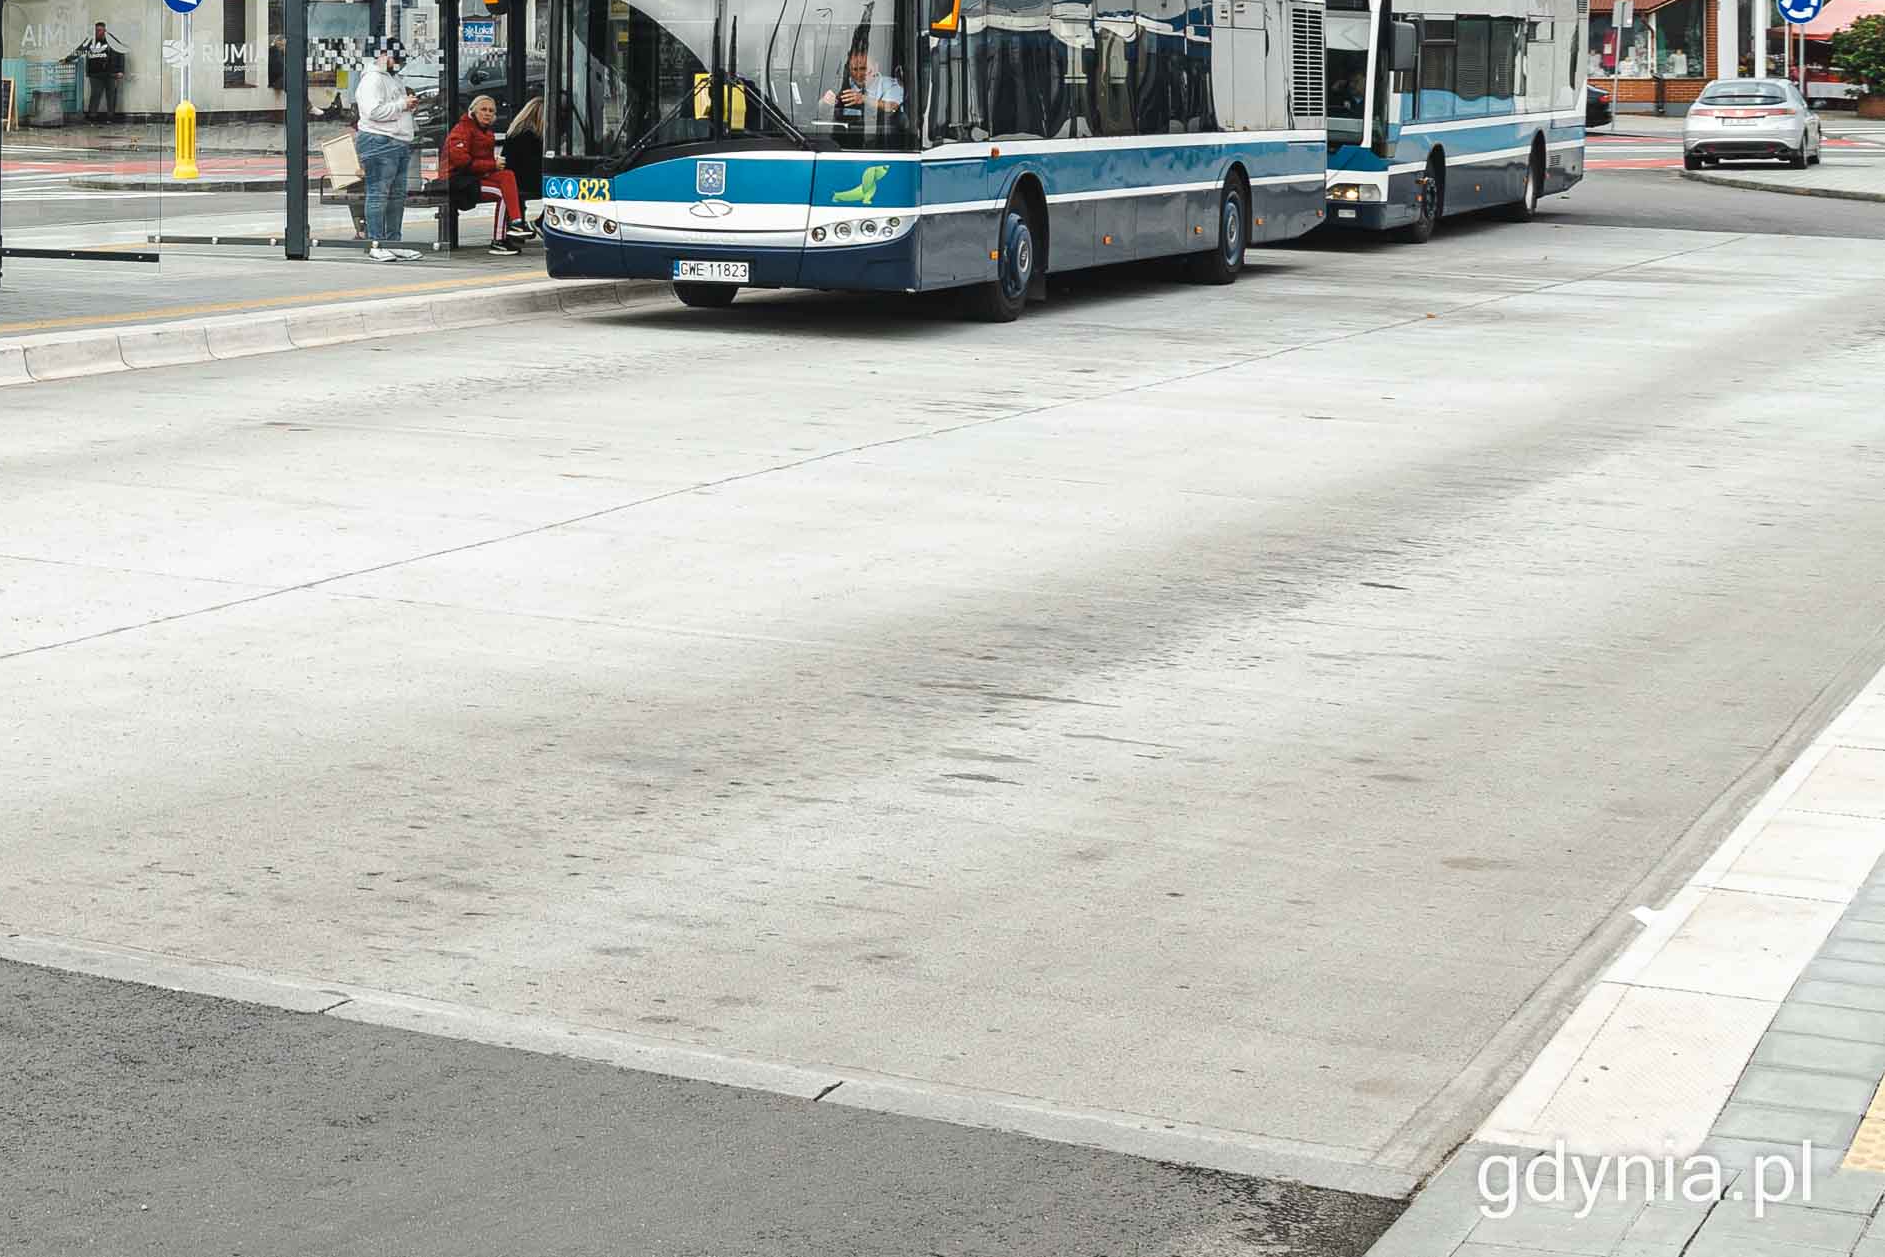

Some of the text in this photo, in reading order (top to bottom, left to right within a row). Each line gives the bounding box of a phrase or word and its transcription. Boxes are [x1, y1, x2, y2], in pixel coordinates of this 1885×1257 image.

[578, 177, 611, 202] 823
[680, 262, 747, 278] GWE 11823
